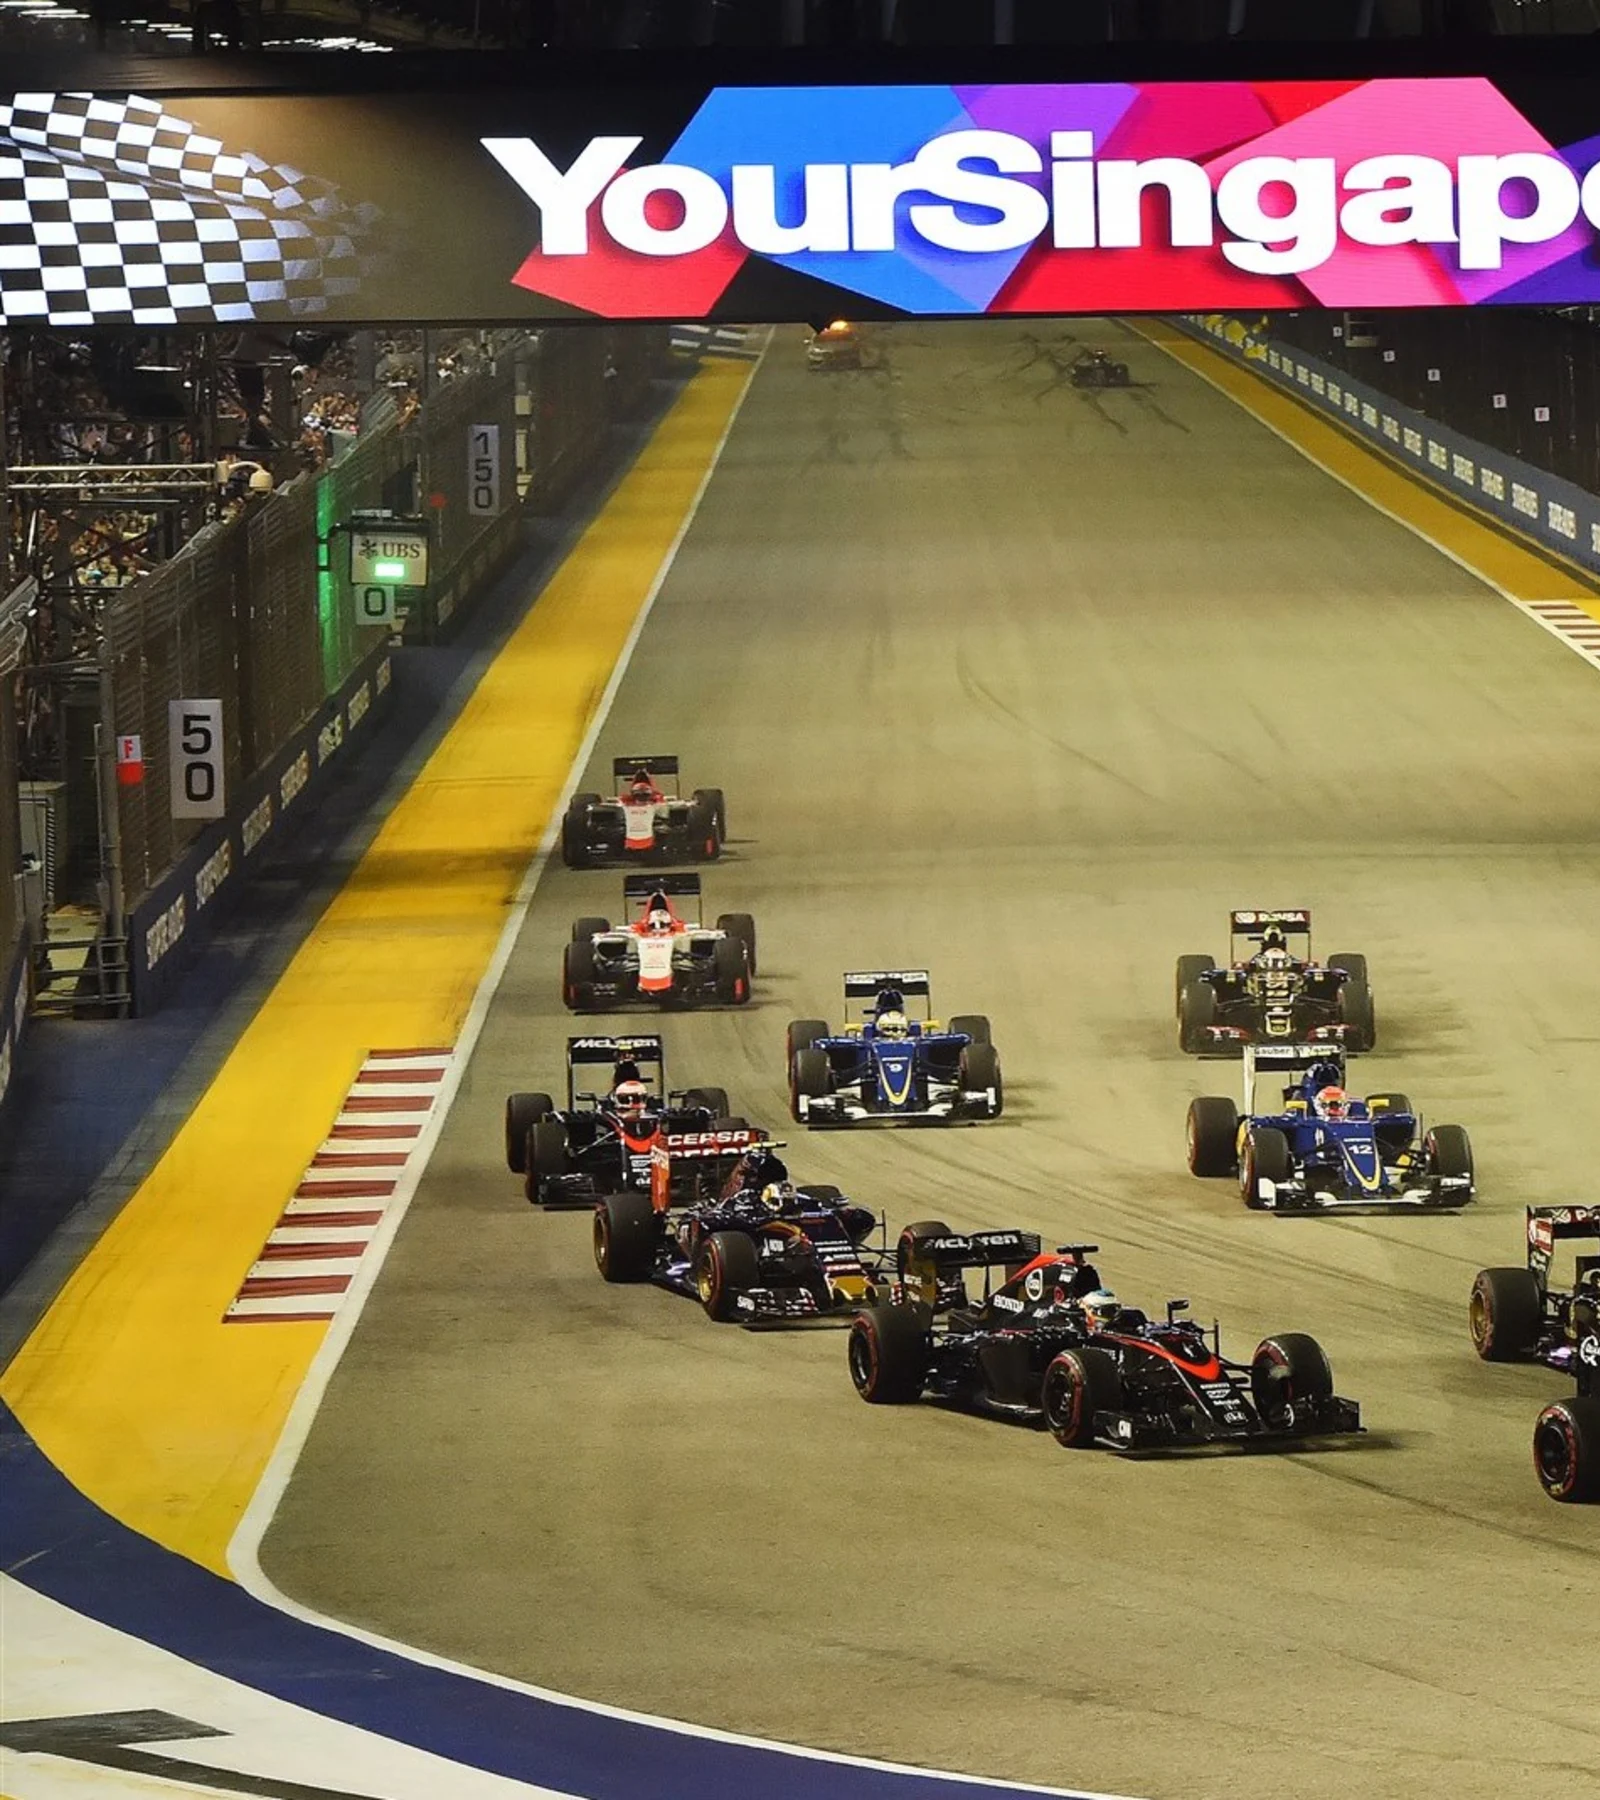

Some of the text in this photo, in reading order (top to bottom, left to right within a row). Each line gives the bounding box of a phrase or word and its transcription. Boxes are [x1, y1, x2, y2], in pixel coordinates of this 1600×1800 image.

[383, 543, 420, 558] UBS
[124, 740, 132, 758] F
[181, 714, 215, 801] 50
[668, 1131, 750, 1146] CEPSA
[1348, 1145, 1373, 1154] 12
